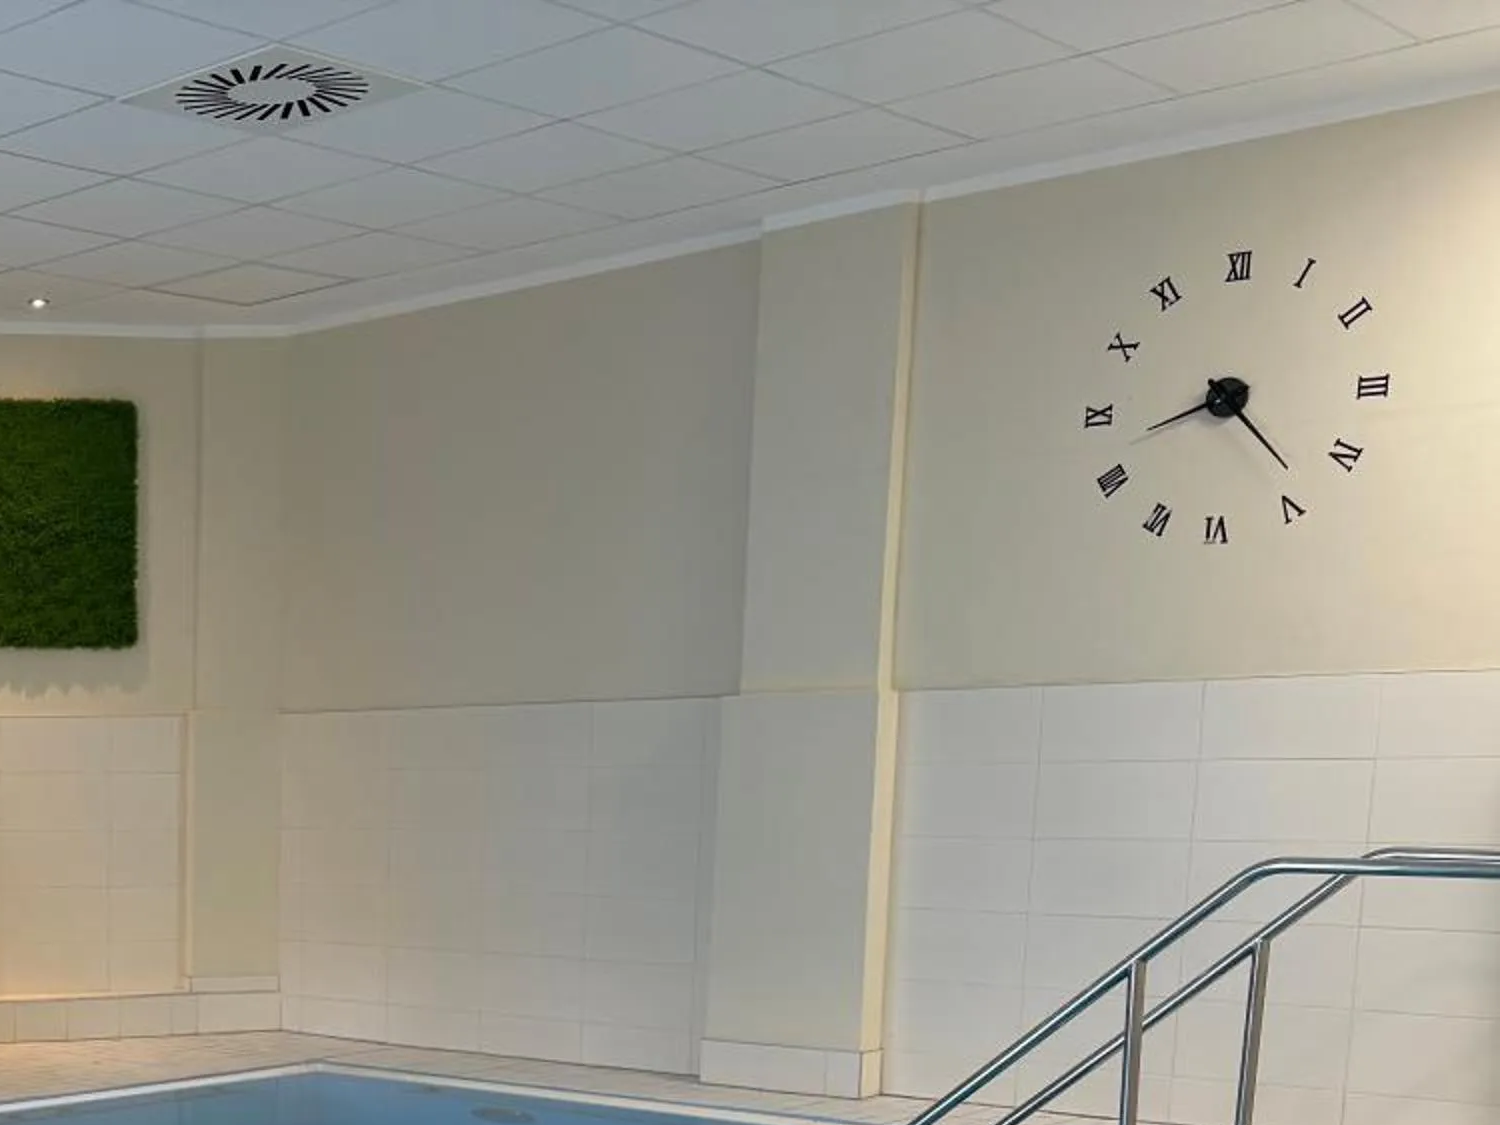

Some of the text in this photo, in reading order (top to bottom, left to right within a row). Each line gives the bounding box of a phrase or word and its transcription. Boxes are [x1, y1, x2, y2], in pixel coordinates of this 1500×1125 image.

[1225, 250, 1252, 282] XII
[1293, 258, 1317, 288] I
[1150, 276, 1182, 312] XI
[1338, 296, 1373, 330] II
[1108, 332, 1140, 363] X
[1356, 373, 1390, 400] III
[1084, 404, 1113, 428] IX
[1328, 438, 1364, 473] IV
[1097, 464, 1129, 499] VIII
[1142, 502, 1172, 537] VII
[1281, 495, 1307, 525] V
[1204, 516, 1228, 545] VI
